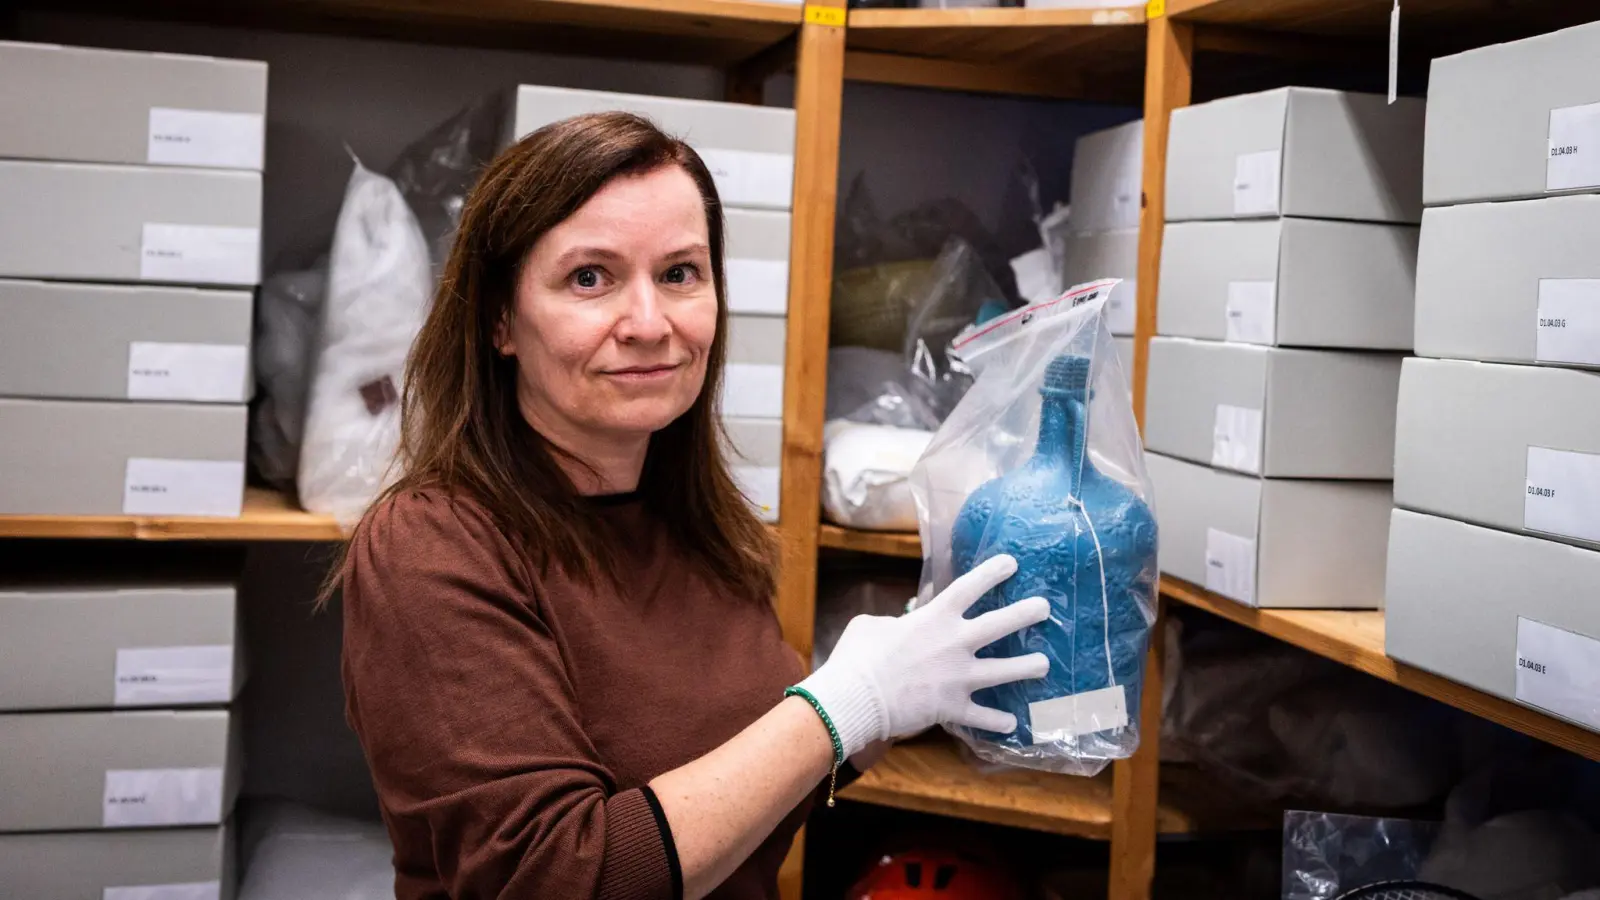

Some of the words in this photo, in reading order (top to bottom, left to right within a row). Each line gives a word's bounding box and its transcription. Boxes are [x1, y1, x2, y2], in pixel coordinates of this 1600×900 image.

[1573, 145, 1578, 154] H
[1562, 318, 1567, 328] G
[1551, 489, 1556, 498] F
[1542, 665, 1547, 675] E
